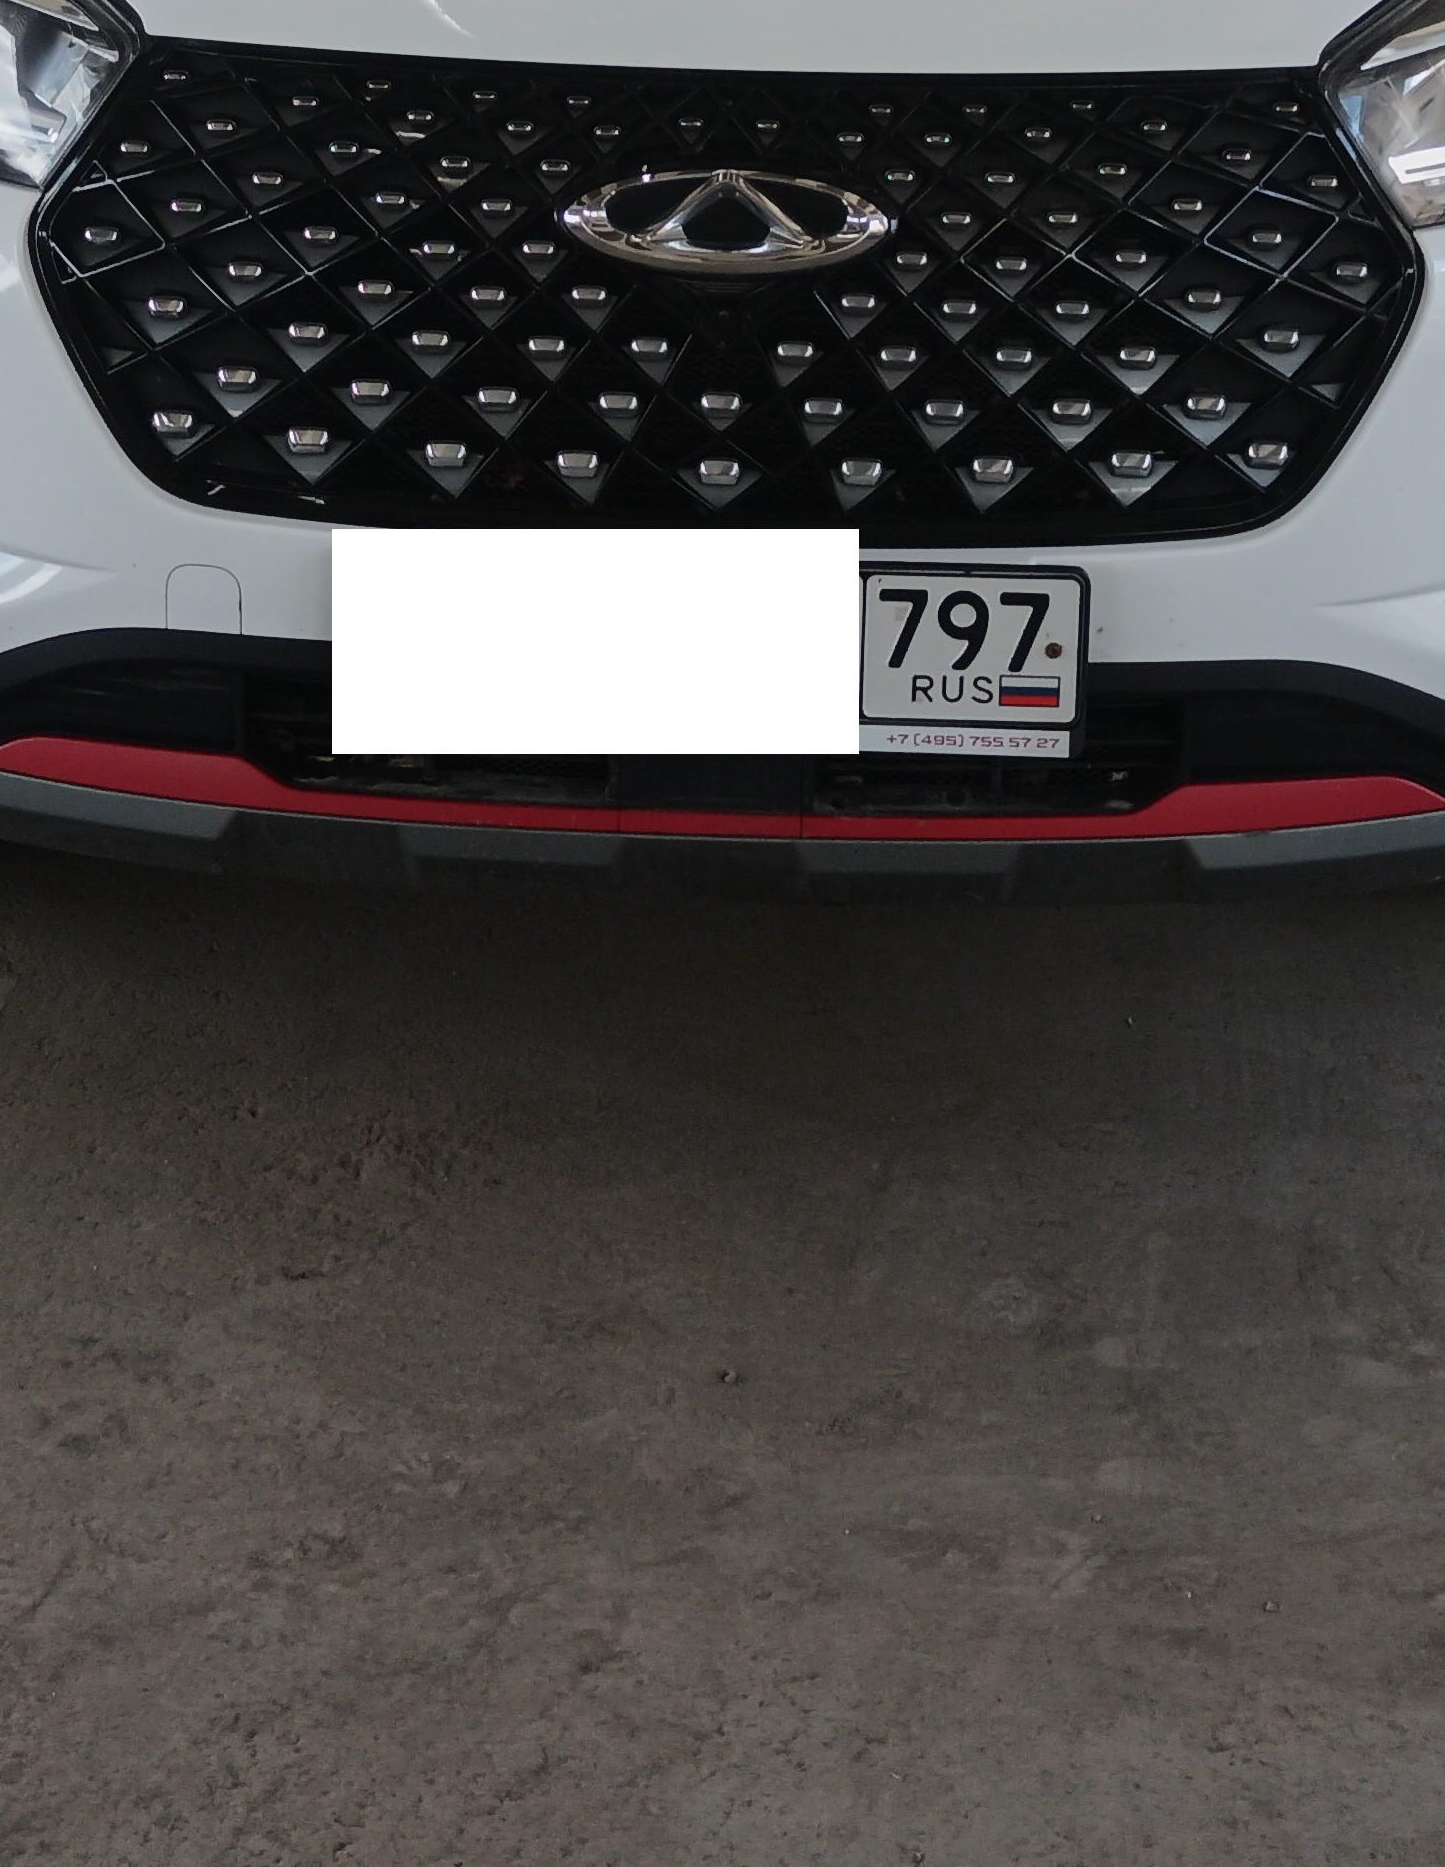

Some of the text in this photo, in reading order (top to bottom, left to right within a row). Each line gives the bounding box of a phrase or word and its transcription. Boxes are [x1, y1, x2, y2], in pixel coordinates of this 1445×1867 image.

[879, 588, 1050, 673] 797
[911, 674, 994, 704] RUS
[886, 734, 909, 745] +7
[970, 735, 1004, 747] 755
[1009, 736, 1032, 748] 57
[1036, 737, 1060, 749] 27
